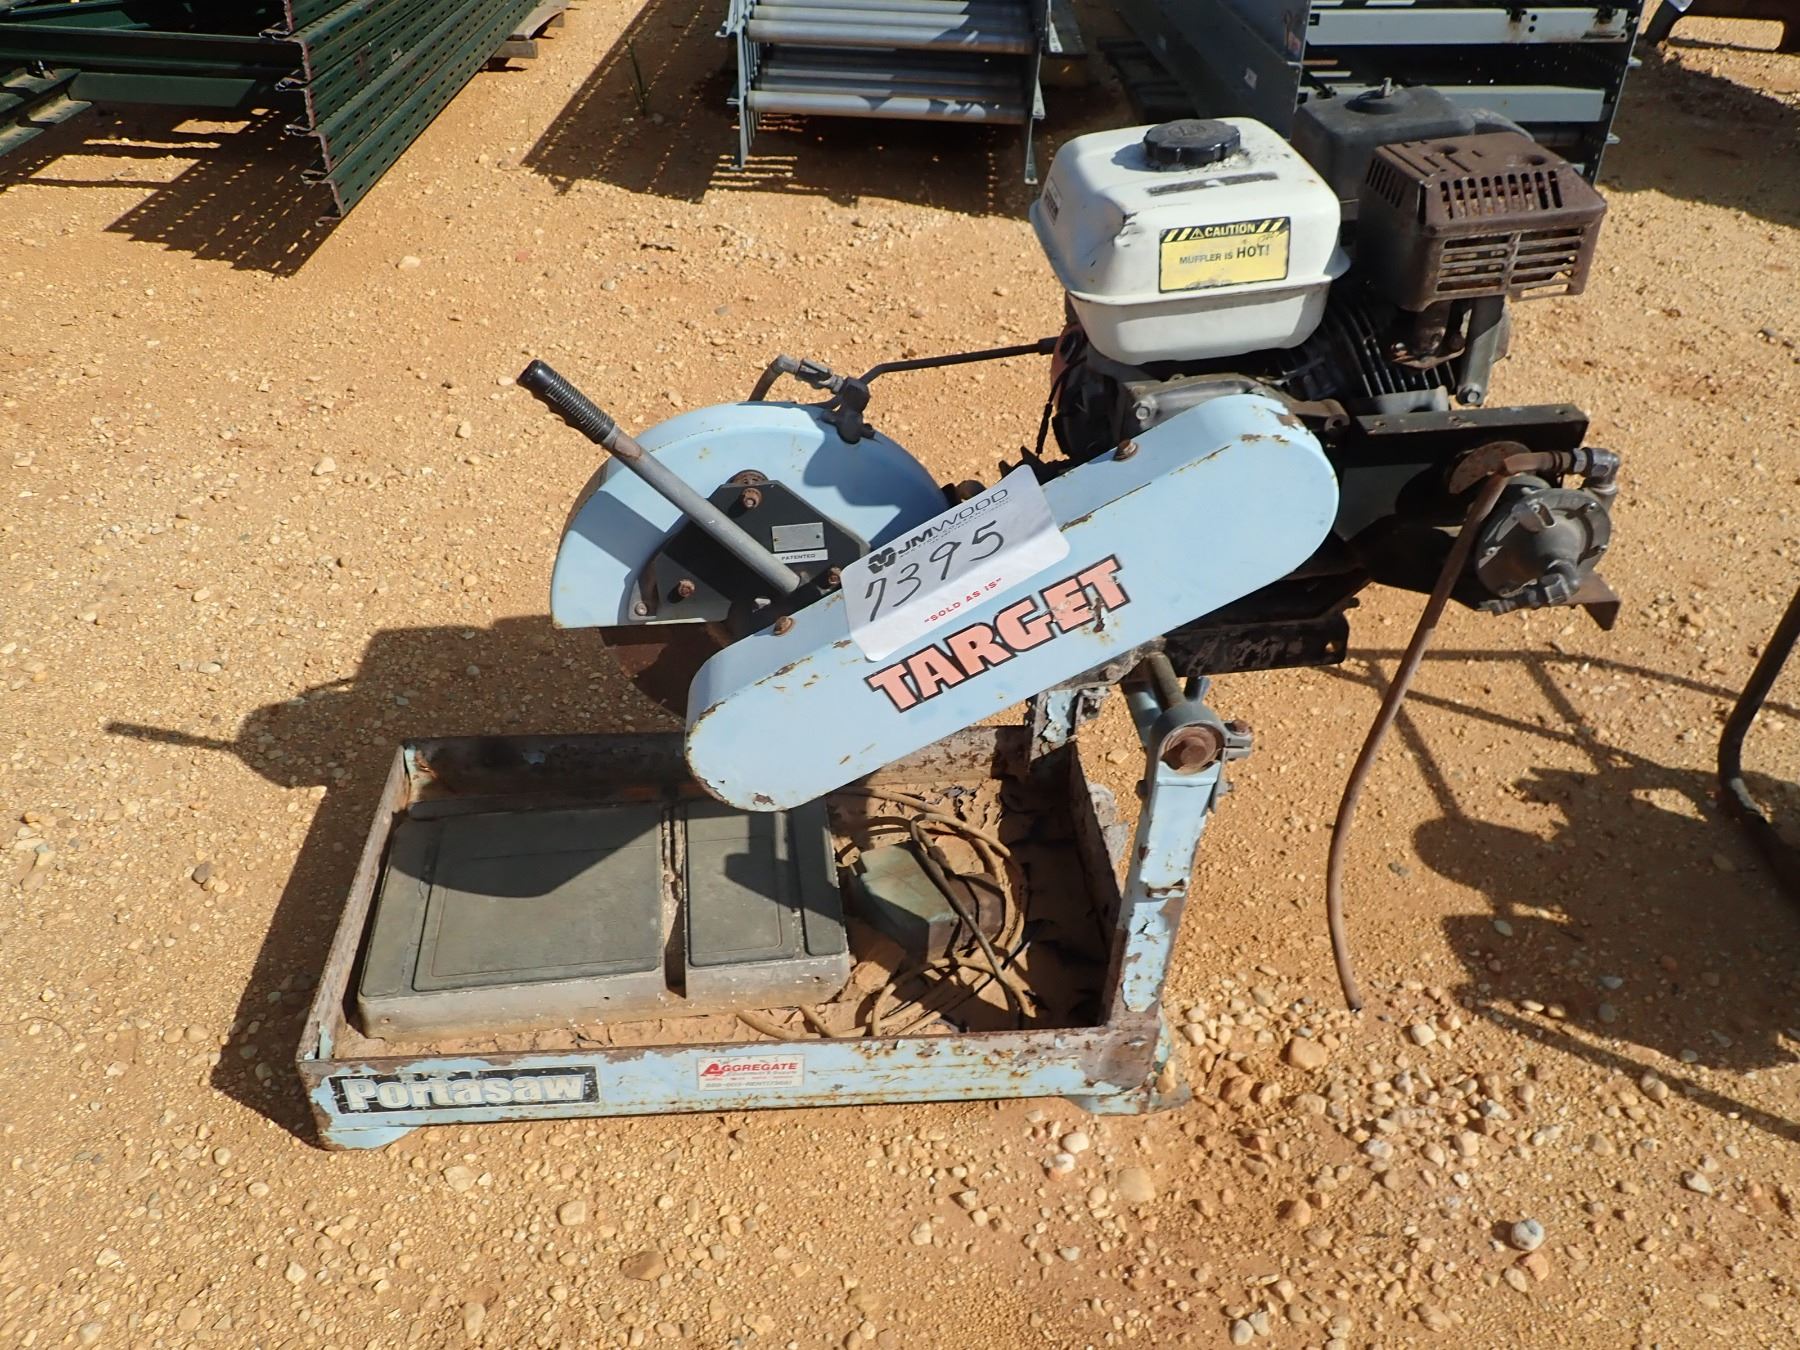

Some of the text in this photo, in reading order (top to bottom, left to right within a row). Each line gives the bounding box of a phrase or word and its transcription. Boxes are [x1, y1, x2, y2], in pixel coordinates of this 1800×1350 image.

[1204, 223, 1256, 238] CAUTION
[1179, 253, 1222, 265] MUFFLER
[1236, 244, 1270, 259] HOT!
[781, 553, 816, 561] PATENTED
[865, 520, 1004, 622] 7395
[966, 590, 981, 602] AS
[863, 553, 1131, 713] TARGET
[700, 1062, 799, 1076] AGGREGATE
[341, 1073, 586, 1111] Portasaw
